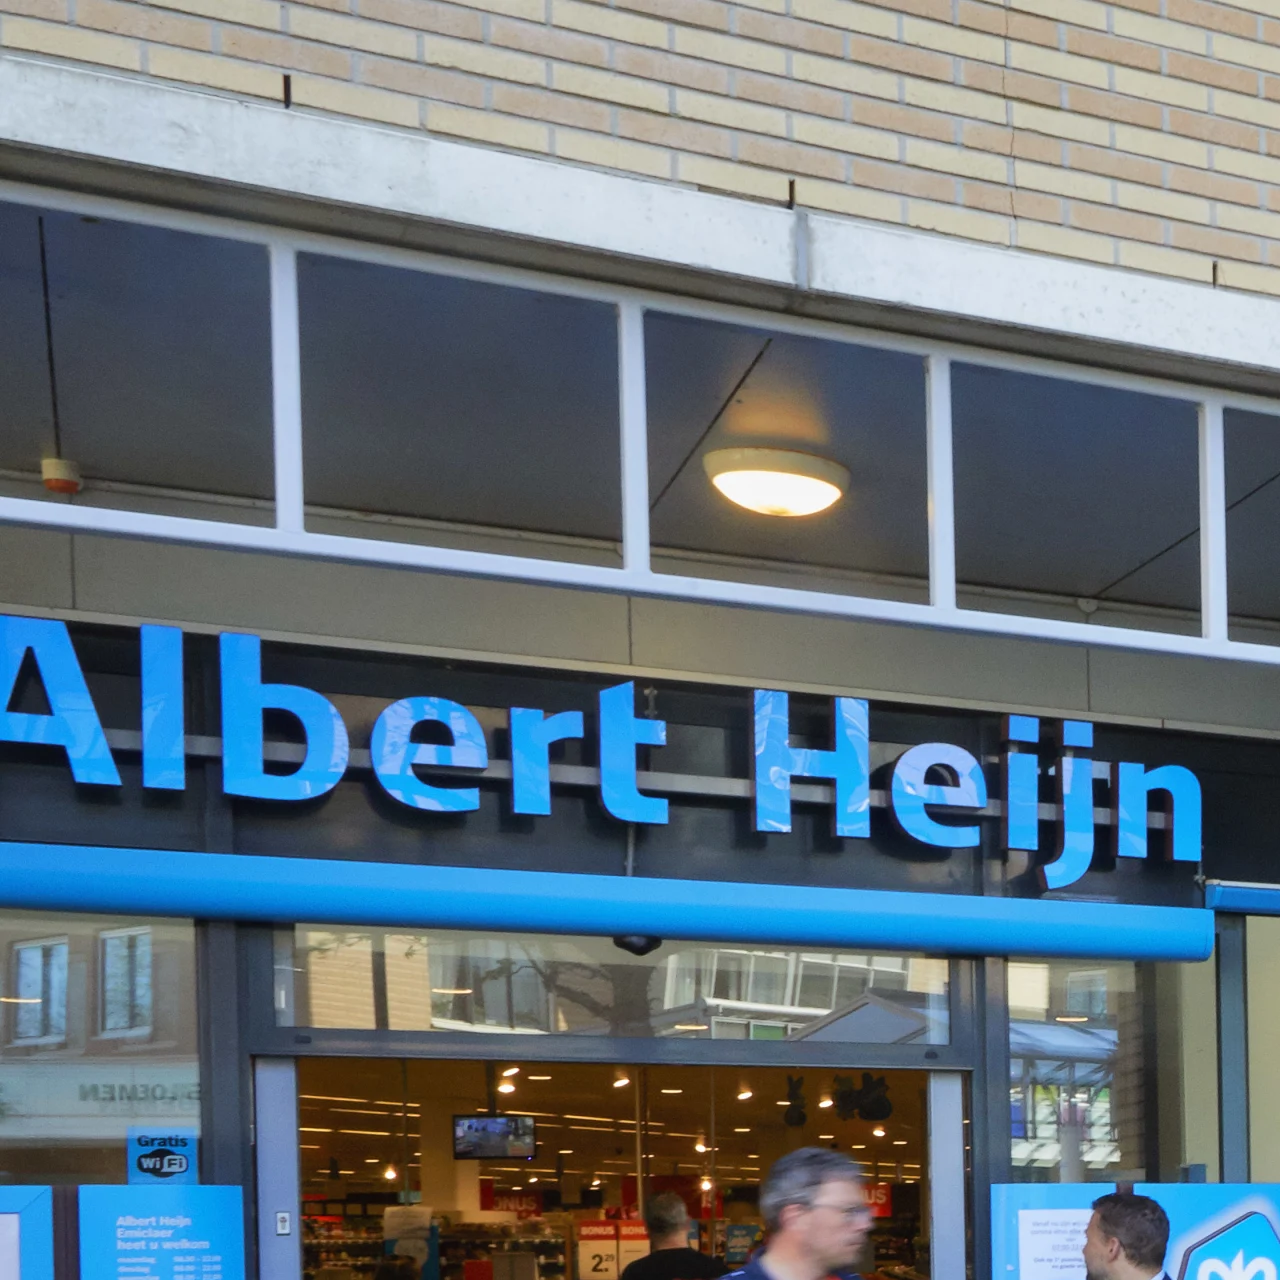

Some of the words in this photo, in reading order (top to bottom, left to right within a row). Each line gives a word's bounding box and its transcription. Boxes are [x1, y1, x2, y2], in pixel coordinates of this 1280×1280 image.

[0, 614, 669, 824] Albert
[752, 689, 1203, 891] Heijn
[137, 1135, 188, 1148] Gratis
[116, 1215, 156, 1227] Albert
[159, 1215, 192, 1229] Heijn
[116, 1227, 173, 1239] Emiclaer
[580, 1226, 616, 1236] BONUS
[116, 1239, 147, 1250] heet
[150, 1241, 158, 1250] u
[162, 1239, 210, 1250] welkom
